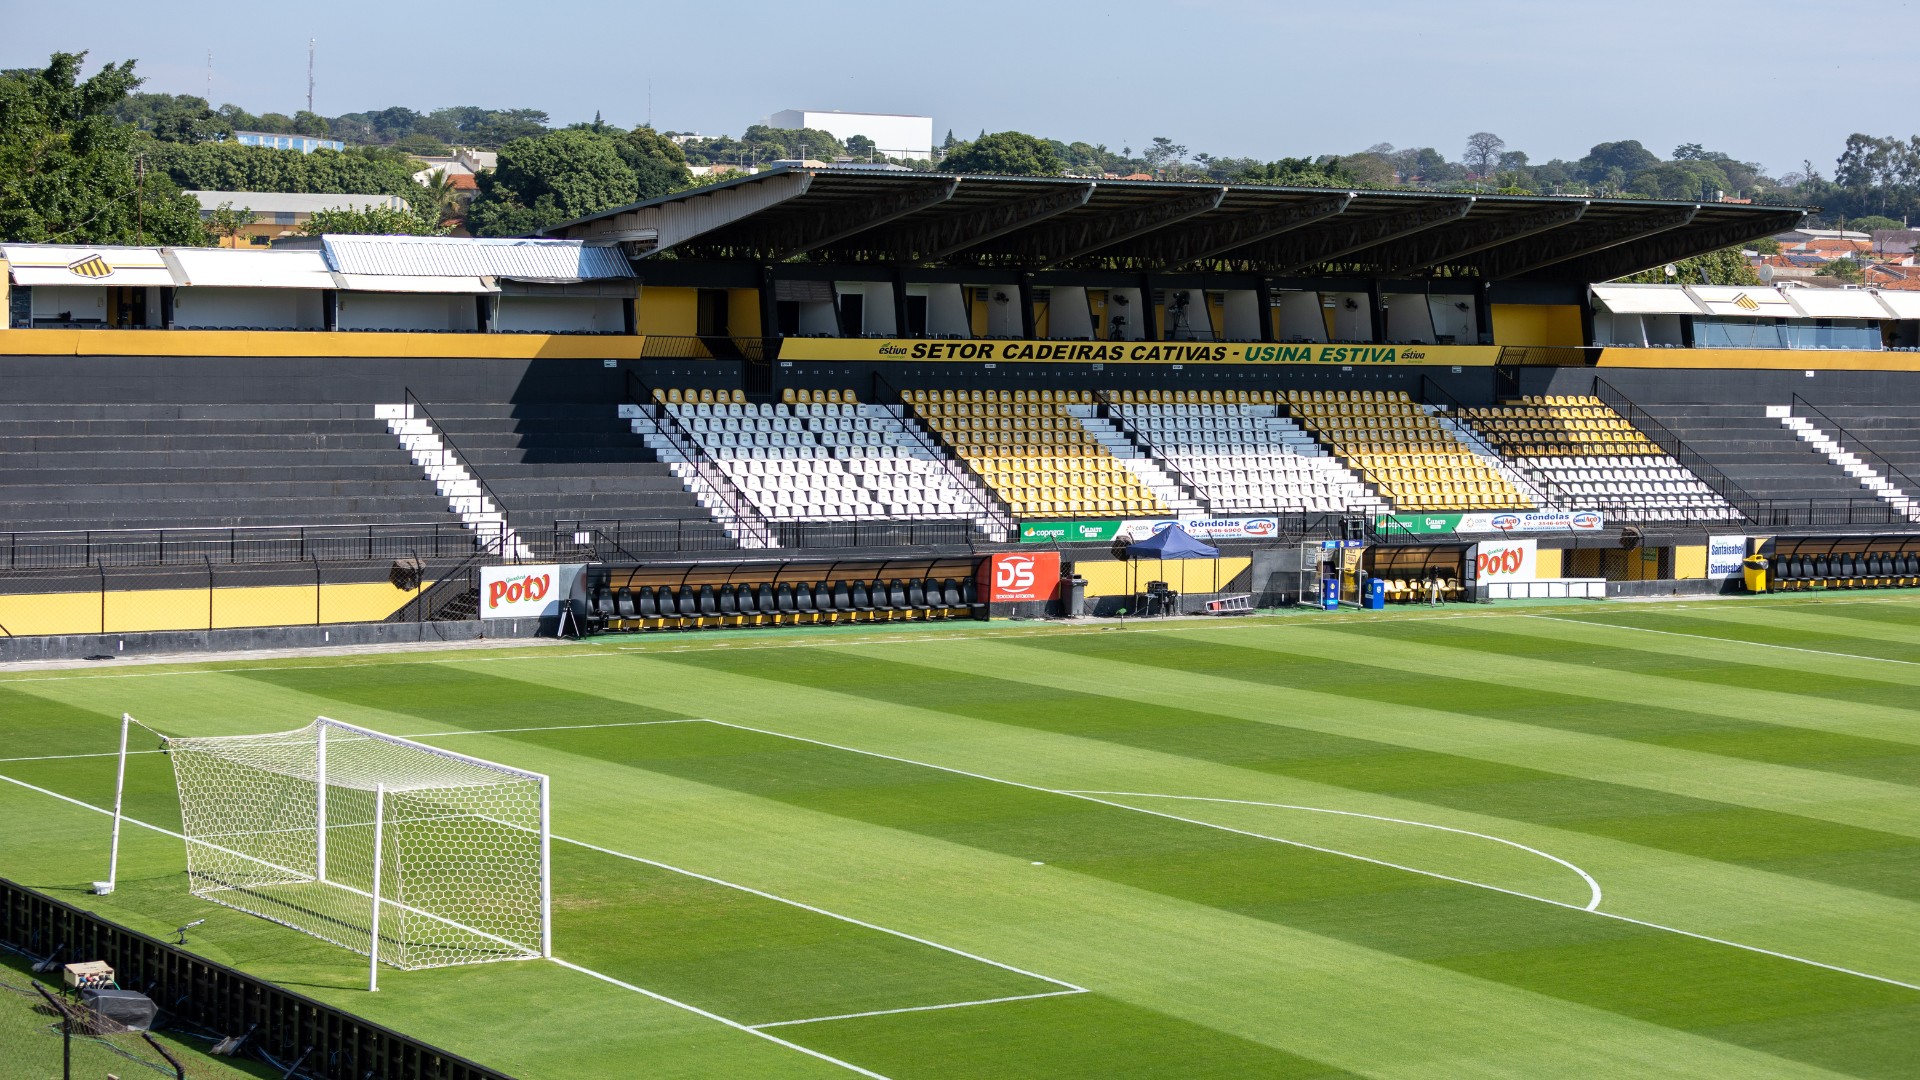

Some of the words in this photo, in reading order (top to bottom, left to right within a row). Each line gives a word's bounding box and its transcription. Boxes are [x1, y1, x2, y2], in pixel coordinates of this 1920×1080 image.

[879, 346, 908, 354] estiva
[911, 343, 994, 359] SETOR
[1002, 344, 1124, 360] CADEIRAS
[1130, 345, 1227, 361] CATIVAS
[1244, 346, 1312, 362] USINA
[1318, 348, 1396, 362] ESTIVA
[1401, 351, 1425, 359] estiva
[1037, 529, 1064, 537] copagaz
[1477, 547, 1523, 580] Poty
[996, 562, 1035, 588] DS
[489, 574, 550, 609] Poty
